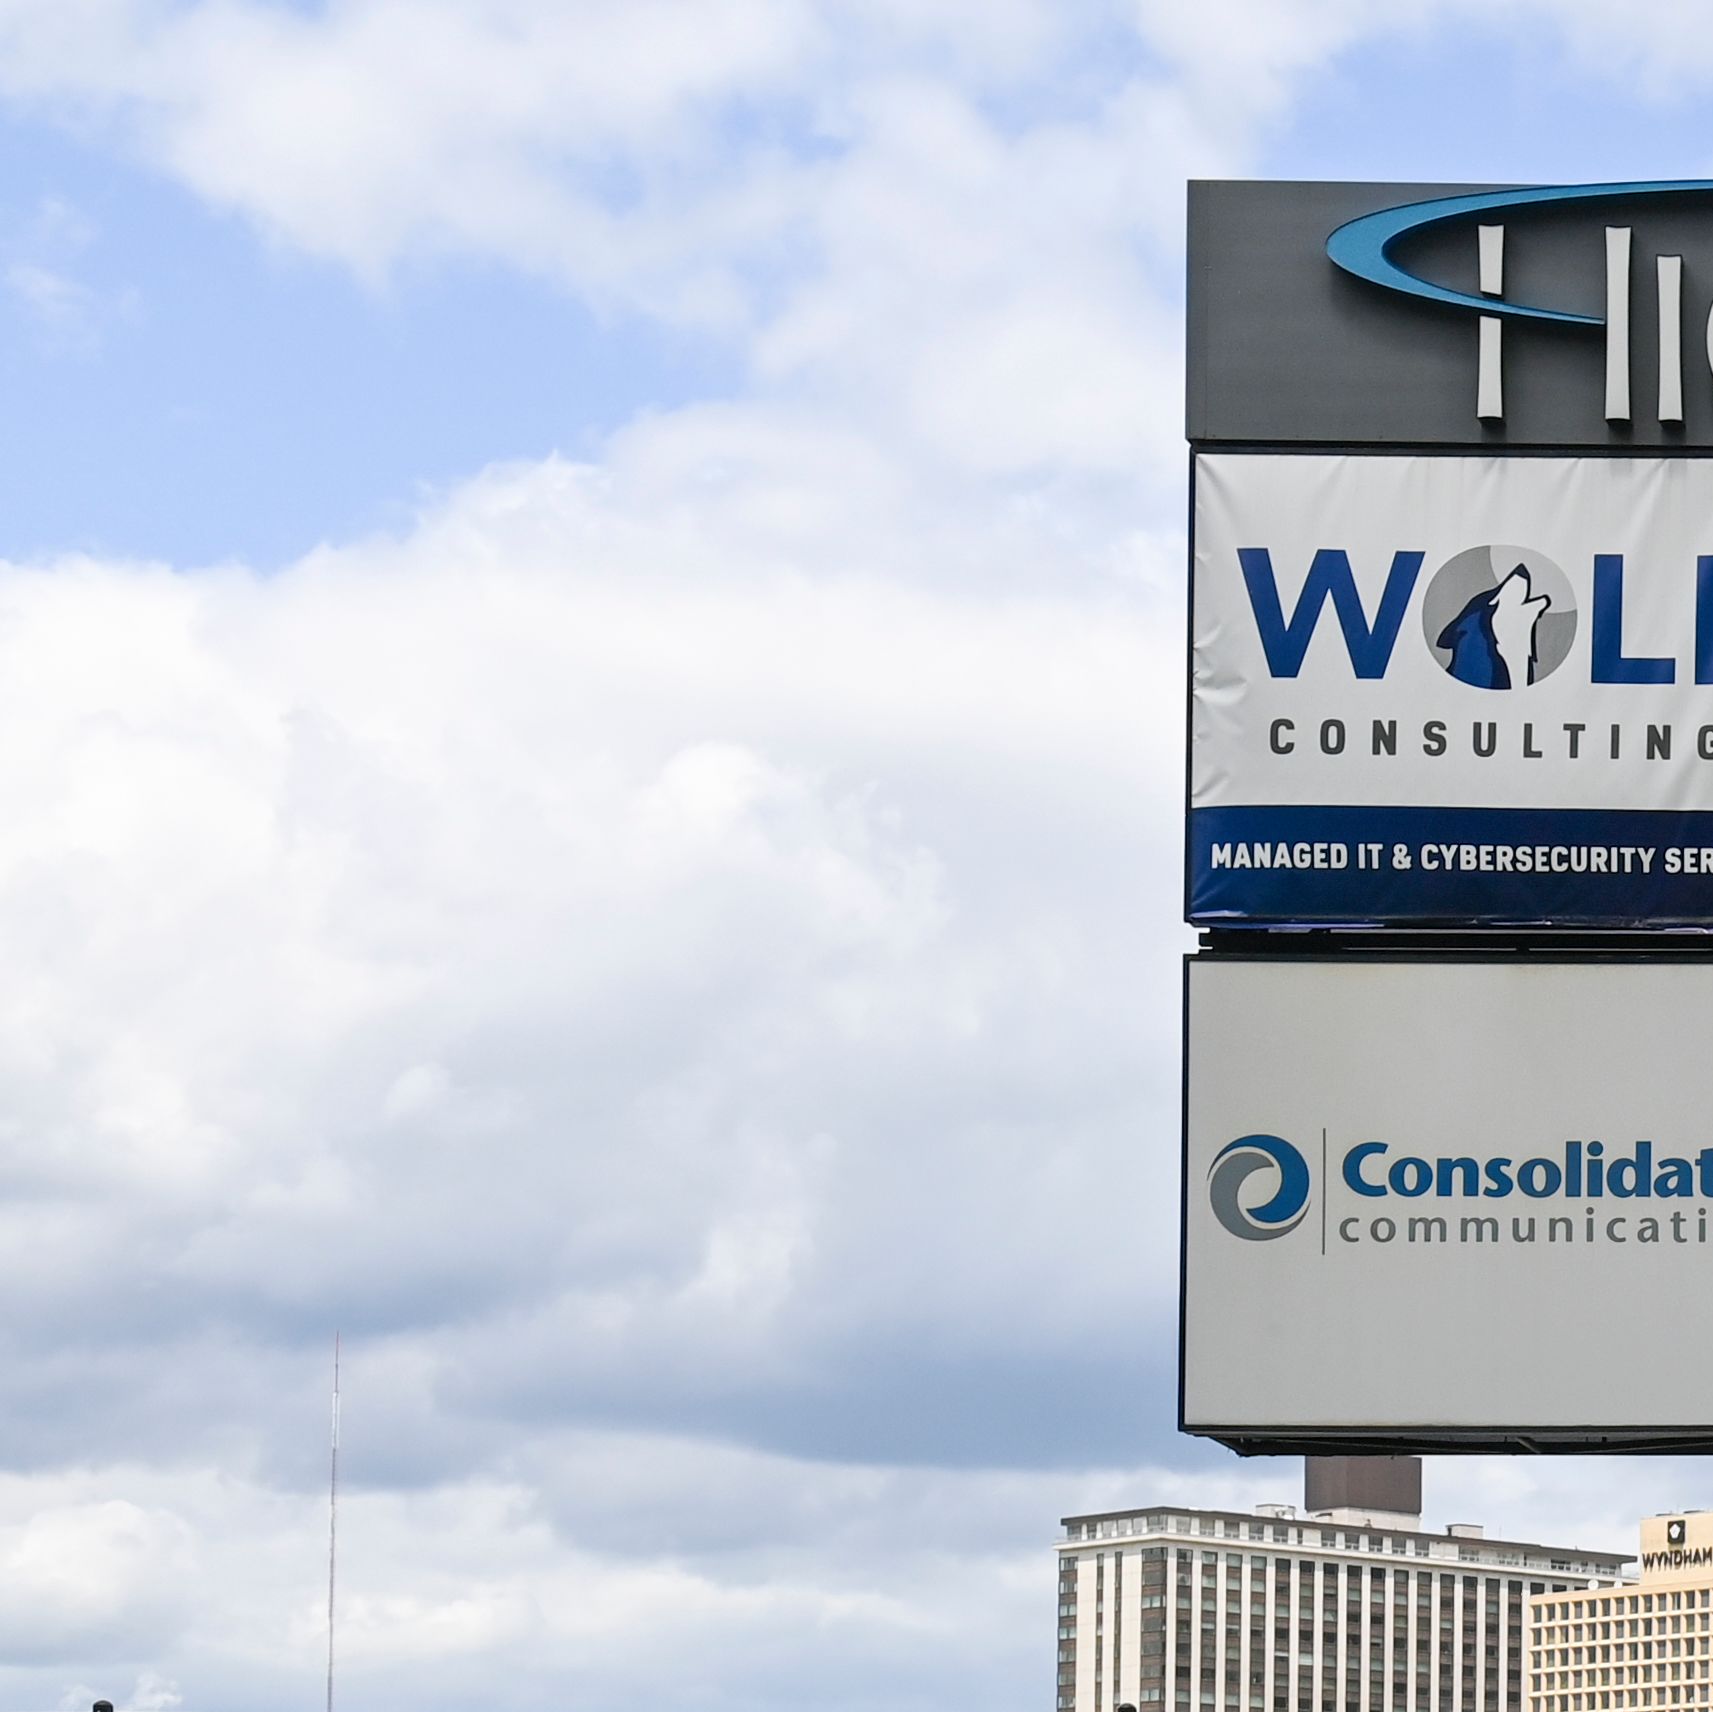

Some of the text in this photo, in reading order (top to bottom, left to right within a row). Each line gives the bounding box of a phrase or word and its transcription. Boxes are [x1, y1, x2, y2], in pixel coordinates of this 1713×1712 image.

[1210, 840, 1349, 871] MANAGED
[1357, 842, 1384, 872] IT
[1392, 842, 1412, 873] &
[1419, 843, 1656, 875] CYBERSECURITY
[1641, 1546, 1713, 1572] WYNDHAM
